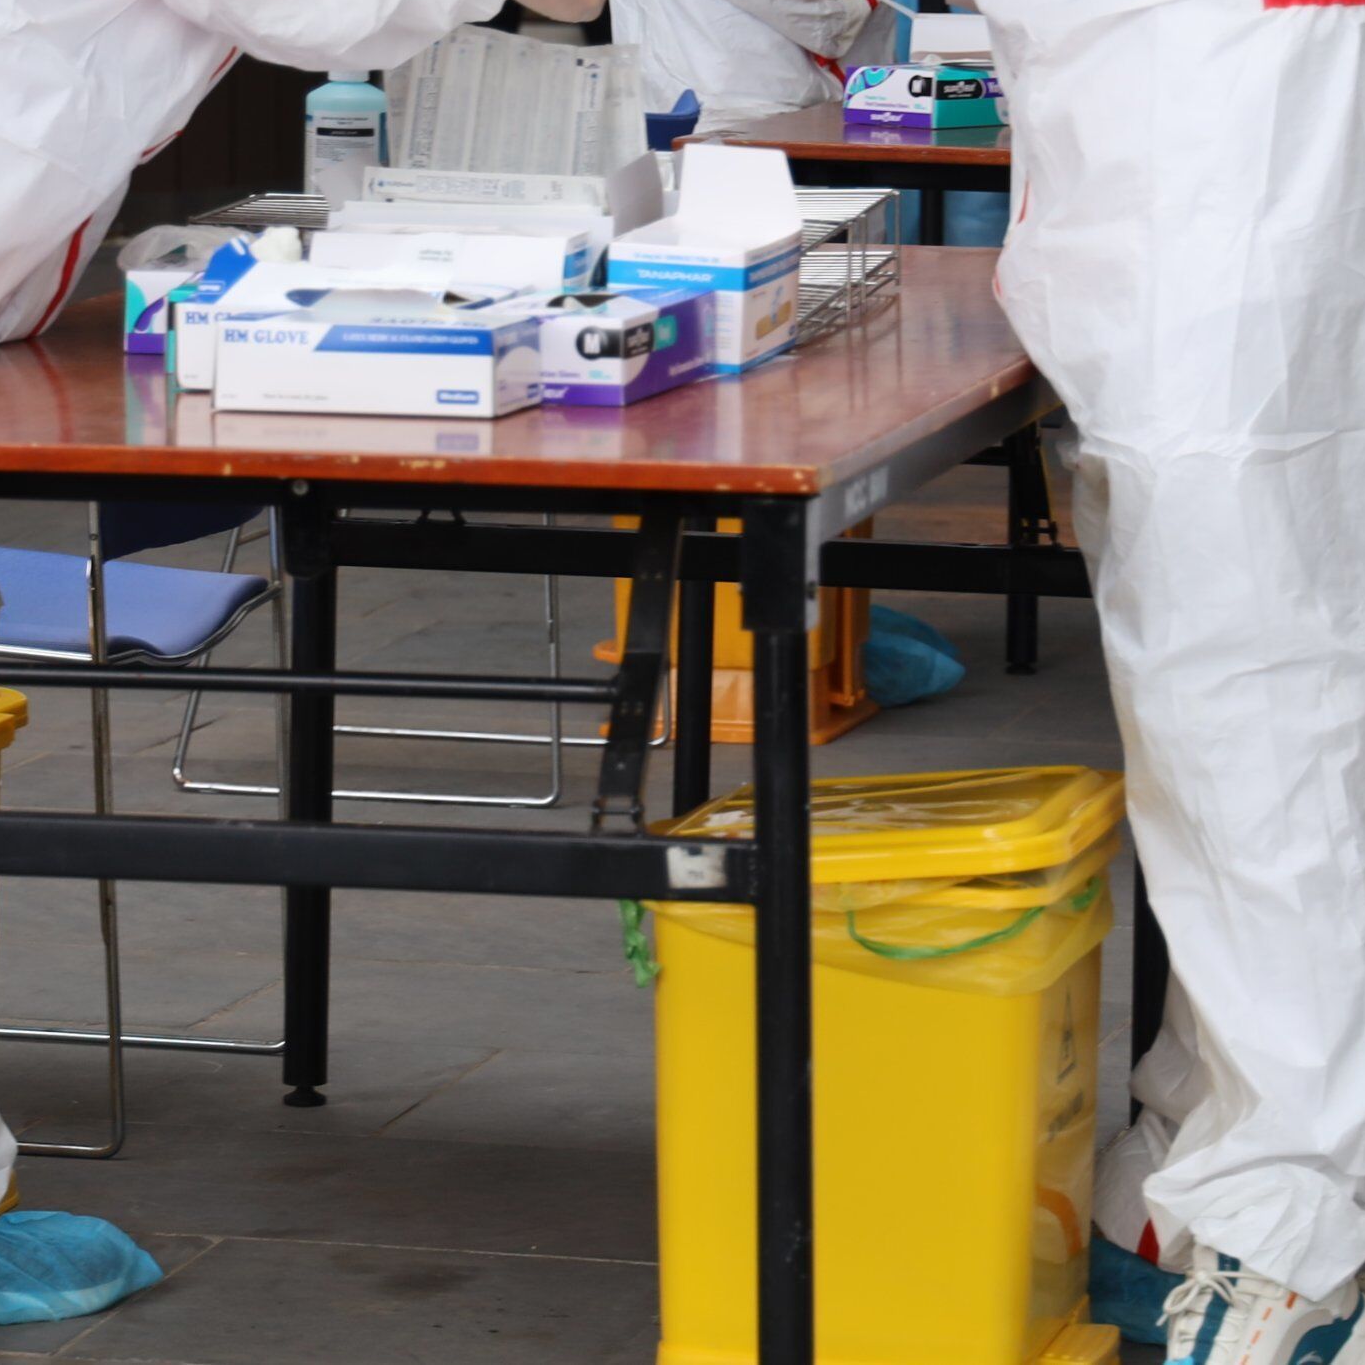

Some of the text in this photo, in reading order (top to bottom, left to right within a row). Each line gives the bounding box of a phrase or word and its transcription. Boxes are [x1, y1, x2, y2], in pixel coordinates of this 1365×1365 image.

[637, 269, 715, 283] TANAPHAR
[185, 311, 209, 325] HM
[224, 328, 309, 345] HM GLOVE
[439, 391, 476, 402] Medium
